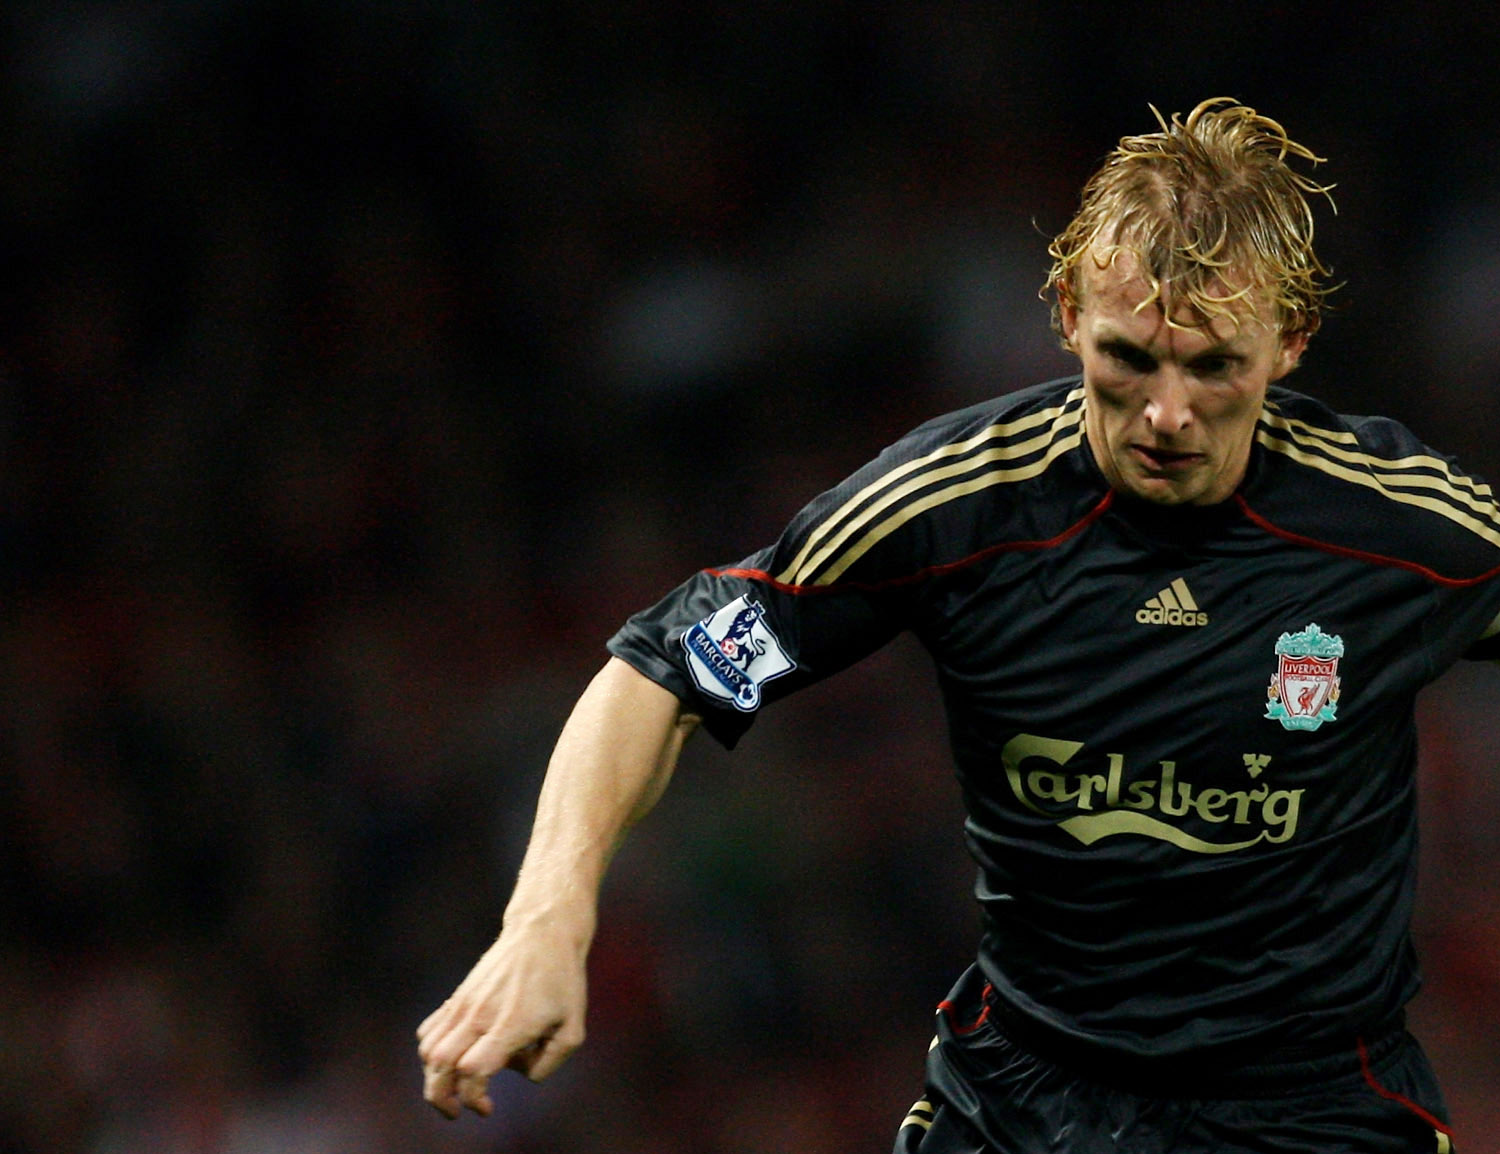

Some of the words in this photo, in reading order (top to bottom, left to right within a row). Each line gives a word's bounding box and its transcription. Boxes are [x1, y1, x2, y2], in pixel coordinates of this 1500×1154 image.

[1135, 606, 1209, 627] adidas
[695, 632, 744, 684] BARCLAYS
[1284, 663, 1332, 675] LIVERPOOL
[1001, 733, 1306, 853] Carlsberg
